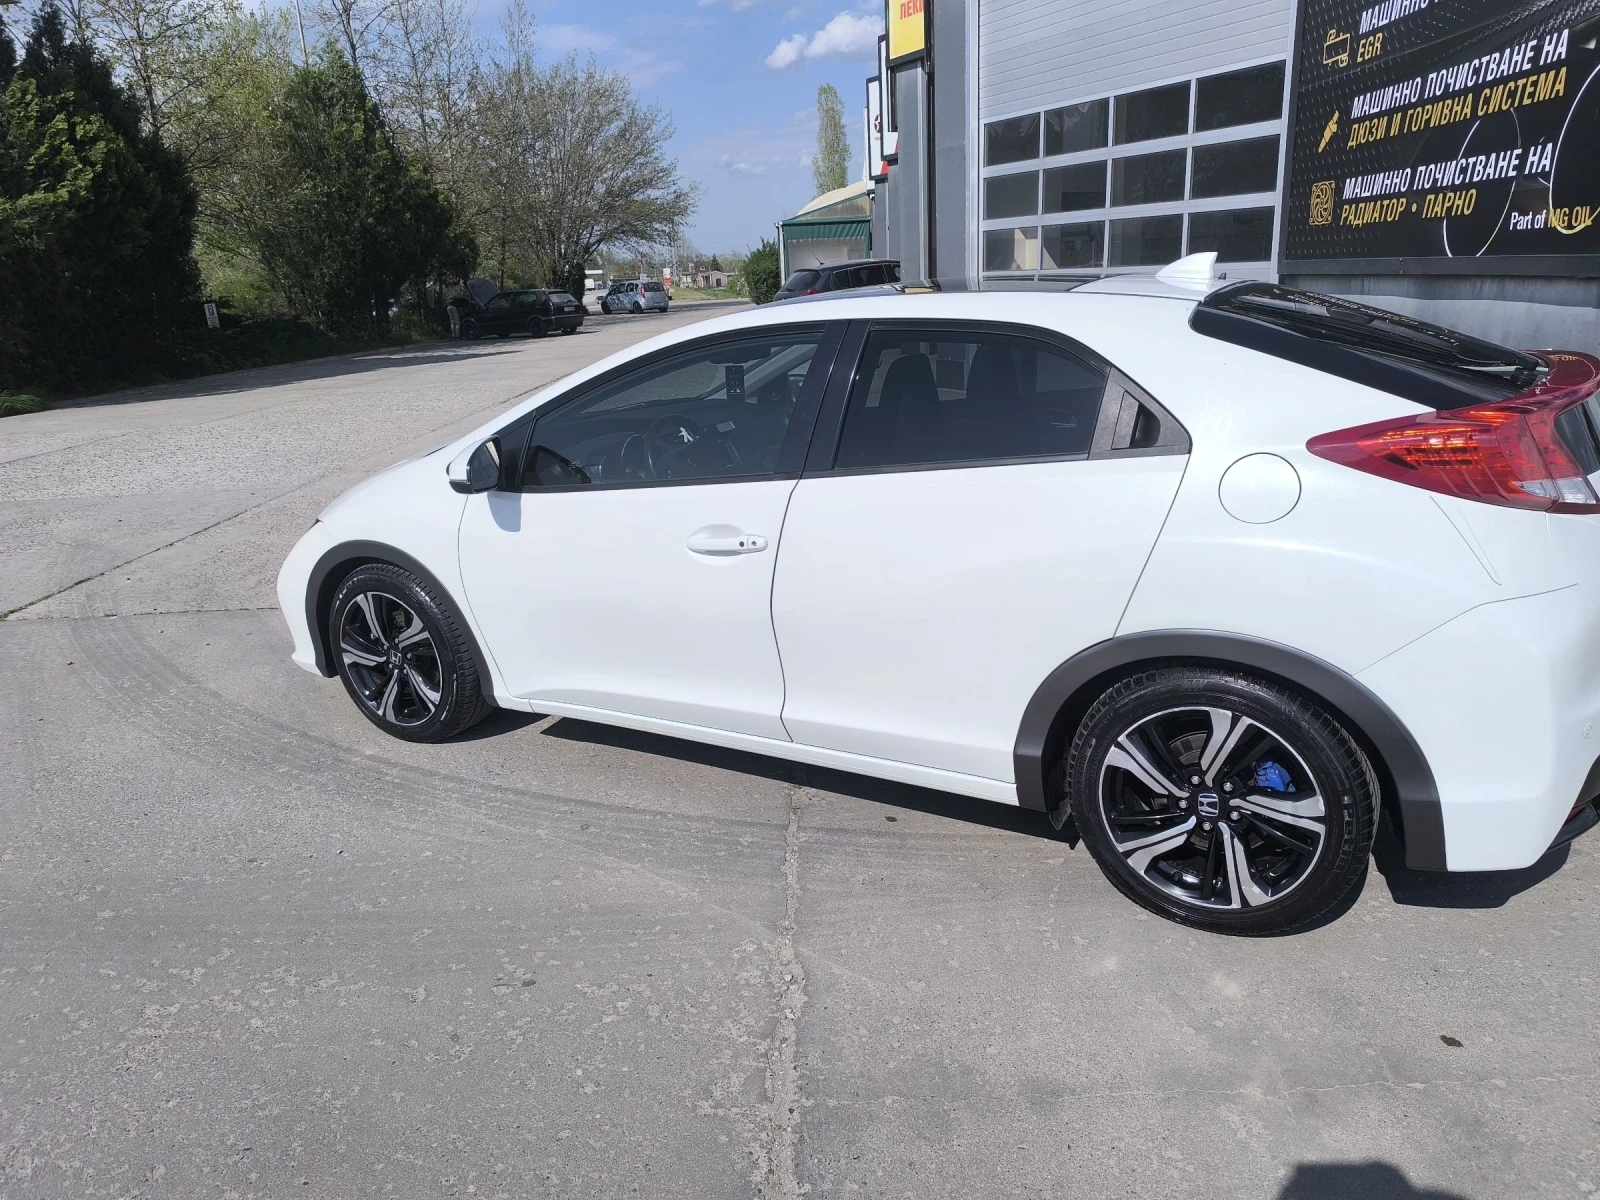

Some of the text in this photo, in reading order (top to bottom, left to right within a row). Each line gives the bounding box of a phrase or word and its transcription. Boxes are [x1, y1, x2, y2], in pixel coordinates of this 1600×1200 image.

[1357, 32, 1383, 63] EGR
[1351, 28, 1569, 119] МАШИННО ПОЧИСТВАНЕ НА
[1347, 66, 1567, 150] ДЮЗИ И ГОРИВНА СИСТЕМА
[1343, 142, 1553, 200] МАШИННО ПОЧИСТВАНЕ НА
[1340, 188, 1477, 229] РАДИАТОР ПАРНО
[1509, 211, 1533, 231] Part
[1534, 209, 1547, 229] of
